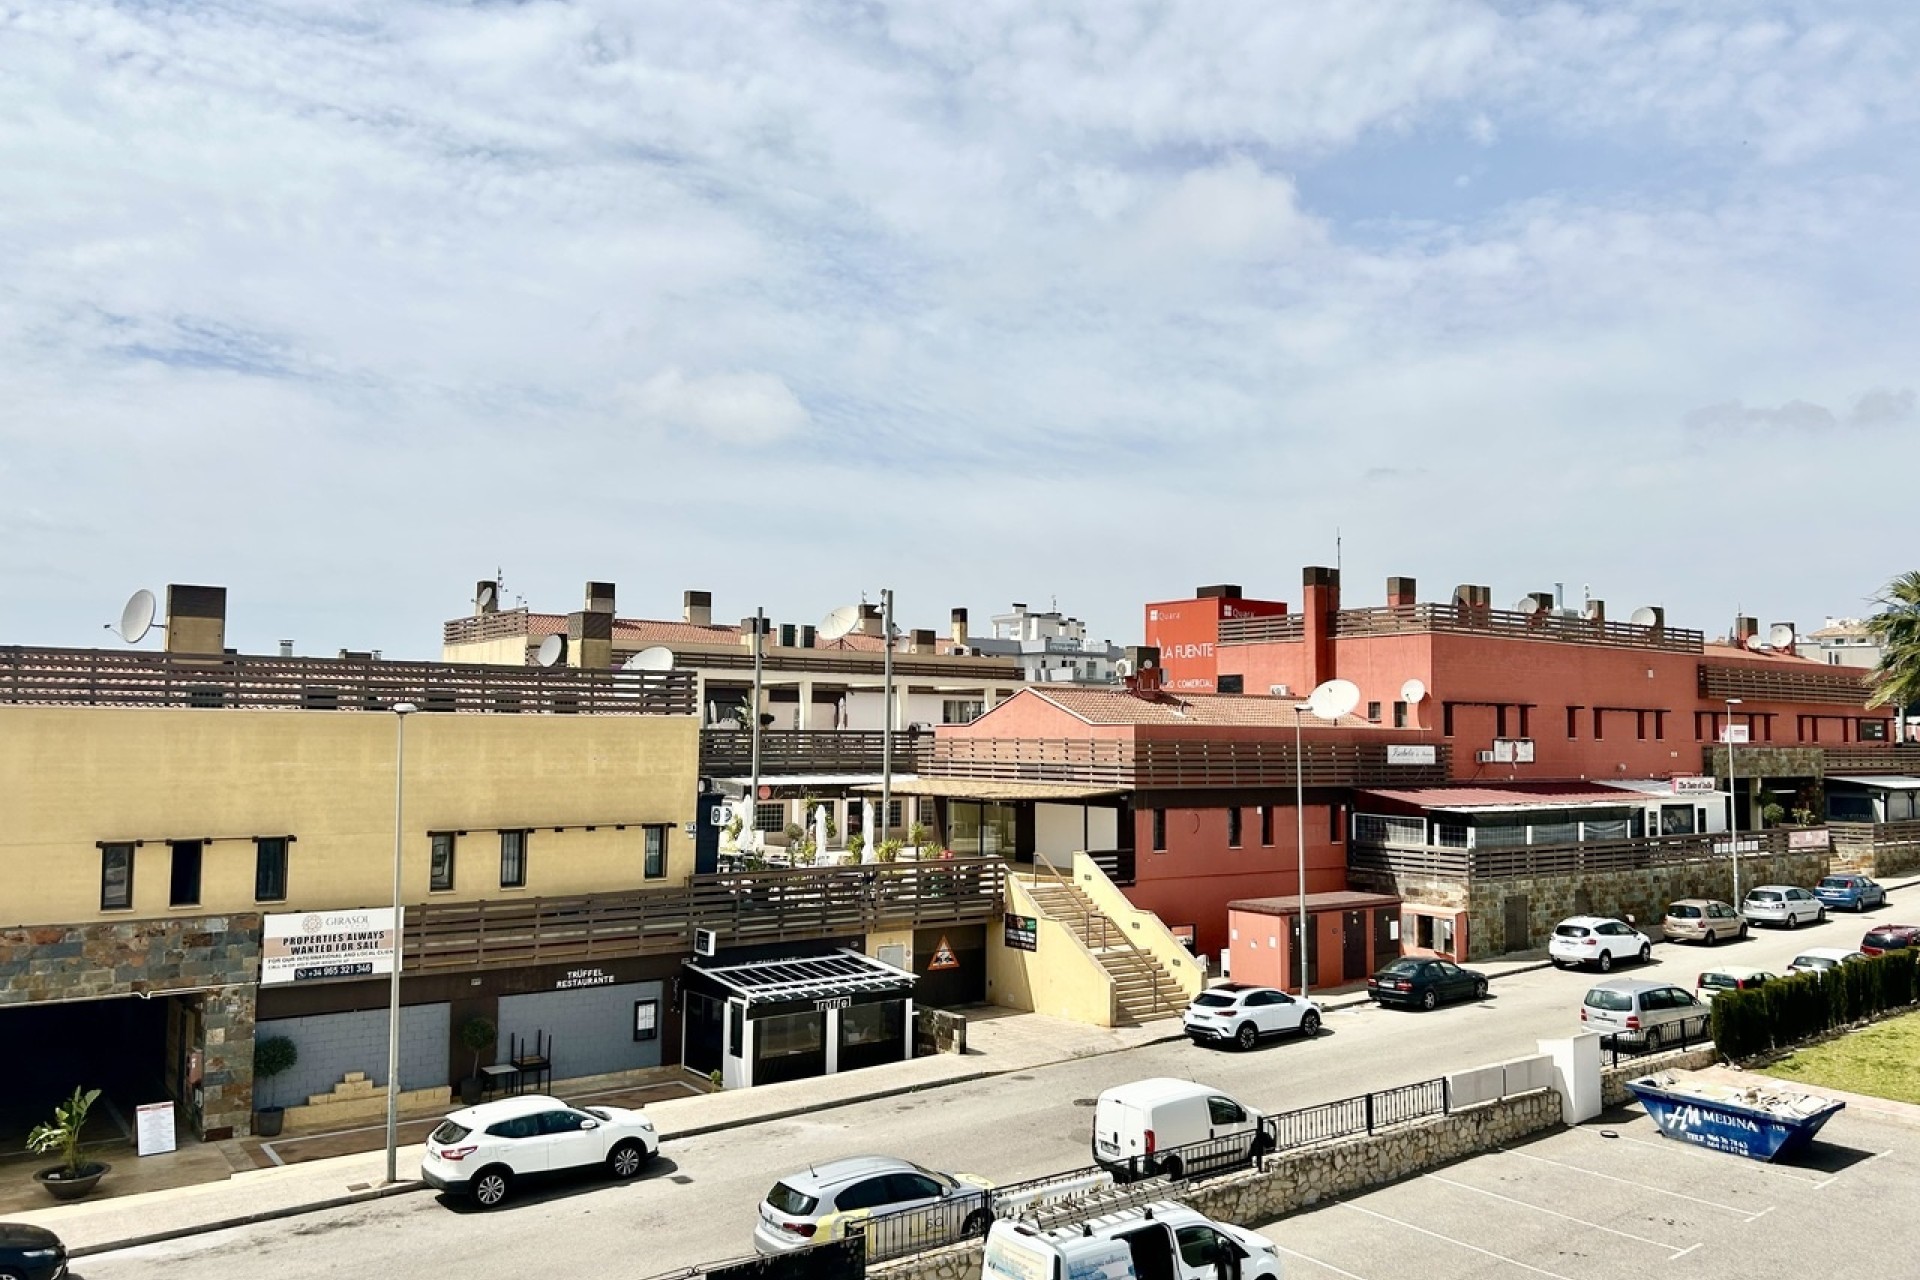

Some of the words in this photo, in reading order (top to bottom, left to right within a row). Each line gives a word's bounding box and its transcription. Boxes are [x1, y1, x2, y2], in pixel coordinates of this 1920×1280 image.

[1160, 645, 1174, 659] LA
[1175, 642, 1214, 659] FUENTE
[1177, 678, 1214, 689] COMERCIAL
[325, 915, 369, 926] GIRASOL
[283, 933, 343, 946] PROPERTIES
[347, 930, 385, 941] ALWAYS
[290, 944, 332, 955] WANTED
[335, 942, 353, 952] FOR
[356, 940, 379, 950] SALE
[567, 968, 604, 980] TRÜFFEL
[556, 975, 615, 989] RESTAURANTE
[1703, 1110, 1759, 1133] MEDINA
